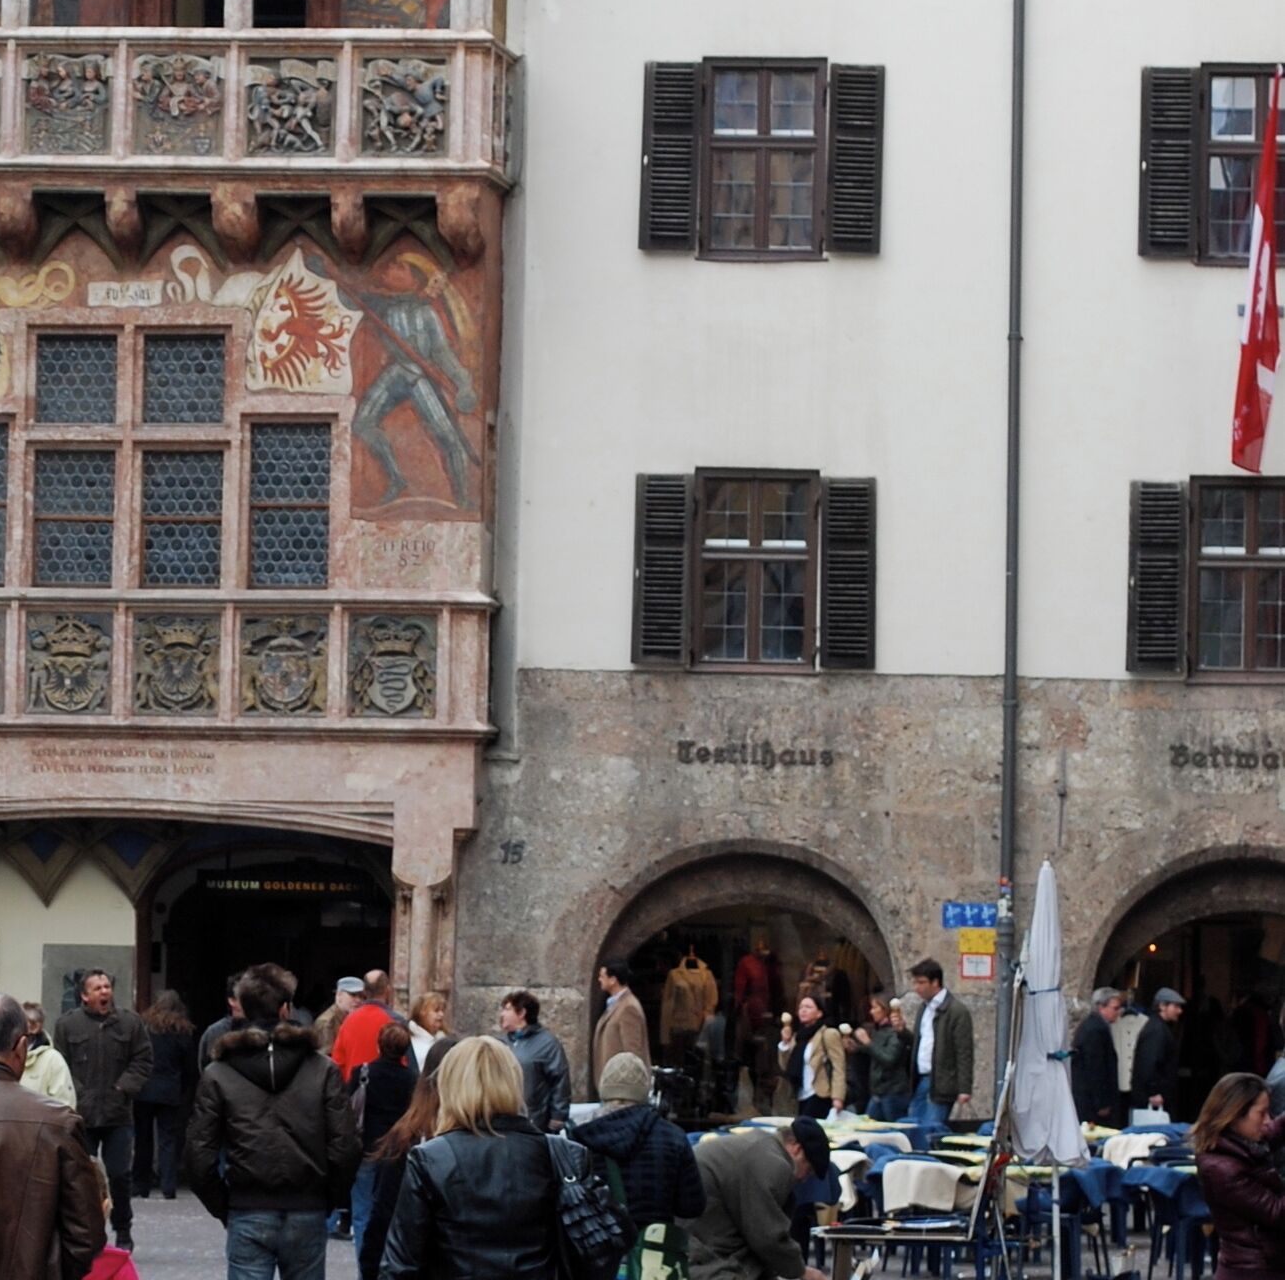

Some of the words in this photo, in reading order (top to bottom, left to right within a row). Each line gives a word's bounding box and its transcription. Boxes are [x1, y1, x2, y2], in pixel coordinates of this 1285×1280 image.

[677, 738, 834, 770] Textilhaus
[1170, 743, 1285, 770] Bettwa
[500, 839, 525, 864] 15
[206, 880, 260, 889] MUSEUM
[263, 880, 325, 891] GOLDENES
